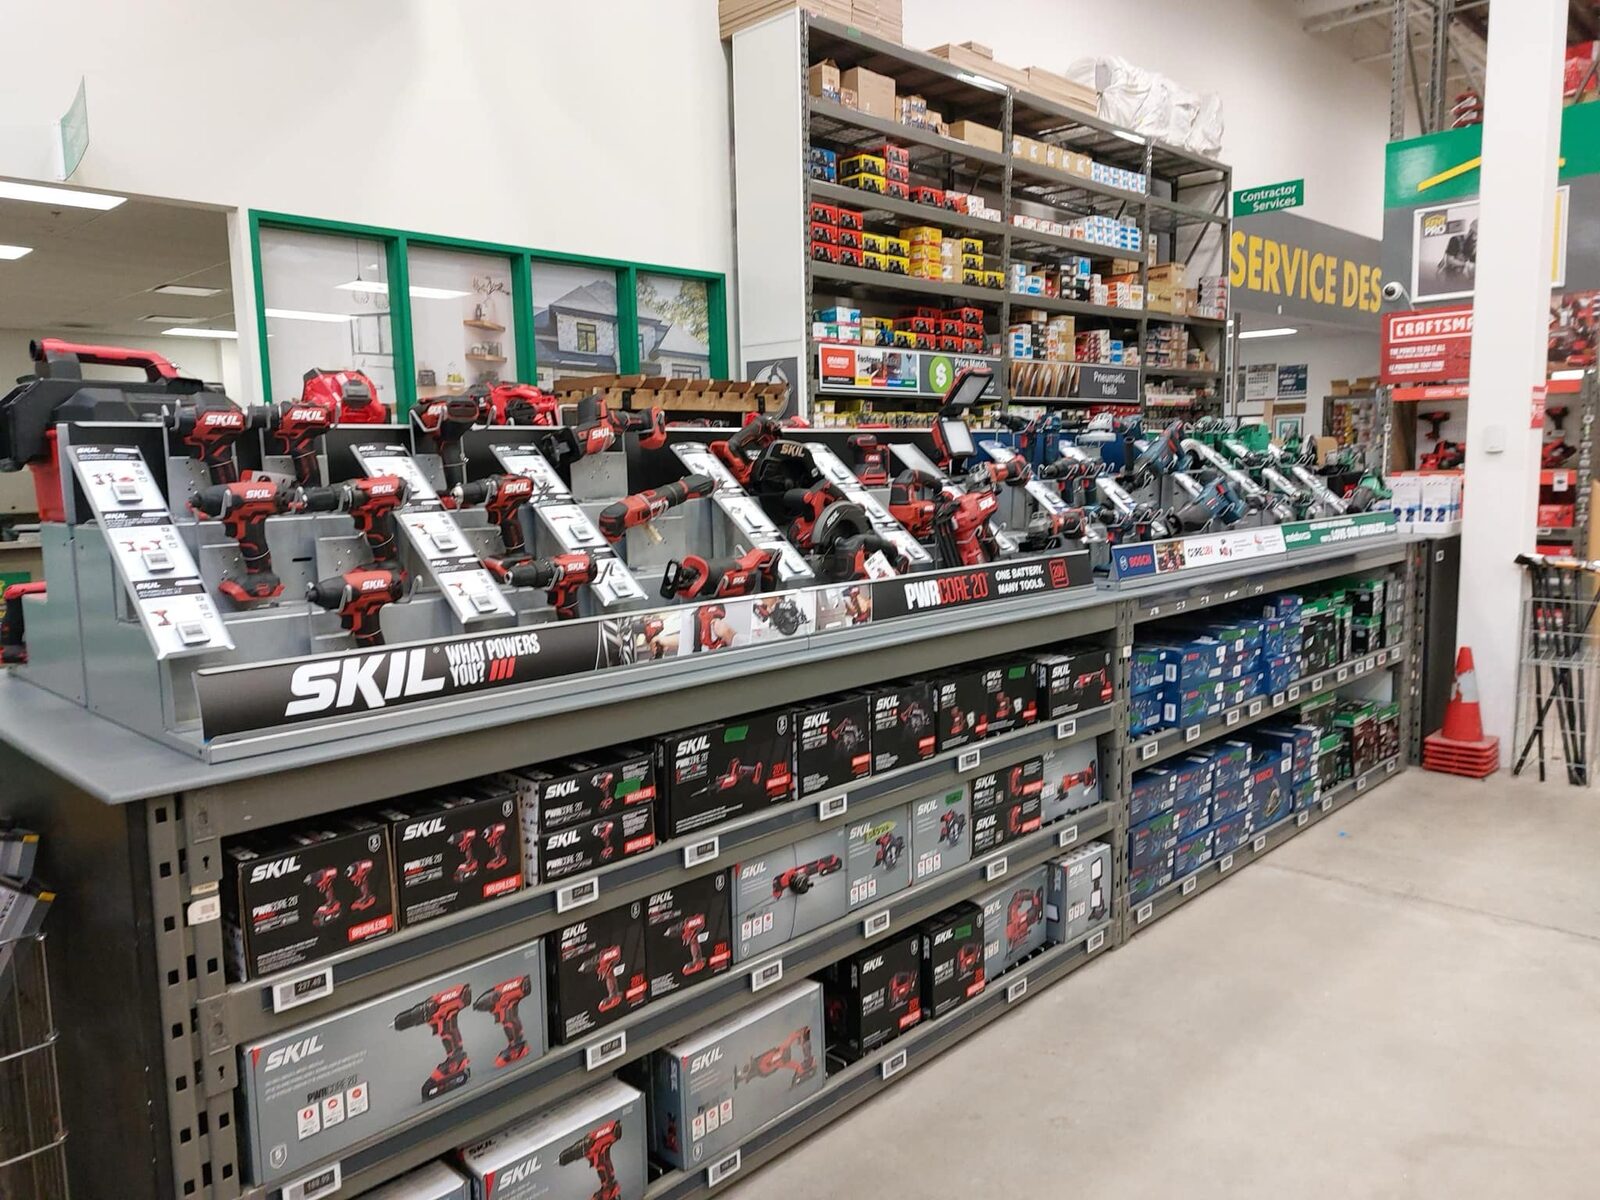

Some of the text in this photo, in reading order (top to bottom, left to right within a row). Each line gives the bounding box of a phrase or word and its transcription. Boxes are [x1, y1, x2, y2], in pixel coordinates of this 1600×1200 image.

[1241, 185, 1296, 203] Contractor
[1253, 197, 1296, 212] Services
[1231, 231, 1383, 313] SERVICE DES
[954, 357, 970, 368] Price
[1093, 371, 1126, 385] Pneumatic
[1102, 383, 1118, 396] Nails
[204, 414, 241, 426] SKIL
[291, 410, 325, 421] SKIL
[780, 443, 805, 458] SKIL
[245, 489, 272, 499] SKIL
[371, 484, 395, 495] SKIL
[505, 481, 530, 494] SKIL
[995, 569, 1011, 582] ONE
[361, 579, 387, 591] SKIL
[903, 572, 989, 610] PWRCORE 20
[998, 579, 1045, 595] MANY TOOLS.
[445, 632, 541, 667] WHAT POWERS
[450, 661, 485, 688] YOU?
[986, 669, 1002, 681] SKIL
[1051, 663, 1071, 678] SKIL
[284, 648, 445, 717] SKIL
[941, 683, 957, 695] SKIL
[875, 695, 900, 712] SKIL
[802, 711, 830, 730] SKIL
[675, 735, 711, 758] SKIL
[544, 779, 580, 800] SKIL
[974, 774, 997, 791] SKIL
[917, 799, 938, 816] SKIL
[402, 817, 447, 842] SKIL
[850, 822, 872, 839] SKIL
[975, 814, 997, 832] SKIL
[546, 829, 581, 850] SKIL
[250, 855, 301, 884] SKIL
[741, 861, 767, 881] SKIL
[648, 890, 674, 907] SKIL
[562, 922, 588, 941] SKIL
[934, 928, 954, 946] SKIL
[862, 955, 884, 975] SKIL
[264, 1034, 324, 1073] SKIL
[689, 1046, 723, 1074] SKIL
[498, 1156, 542, 1191] SKIL
